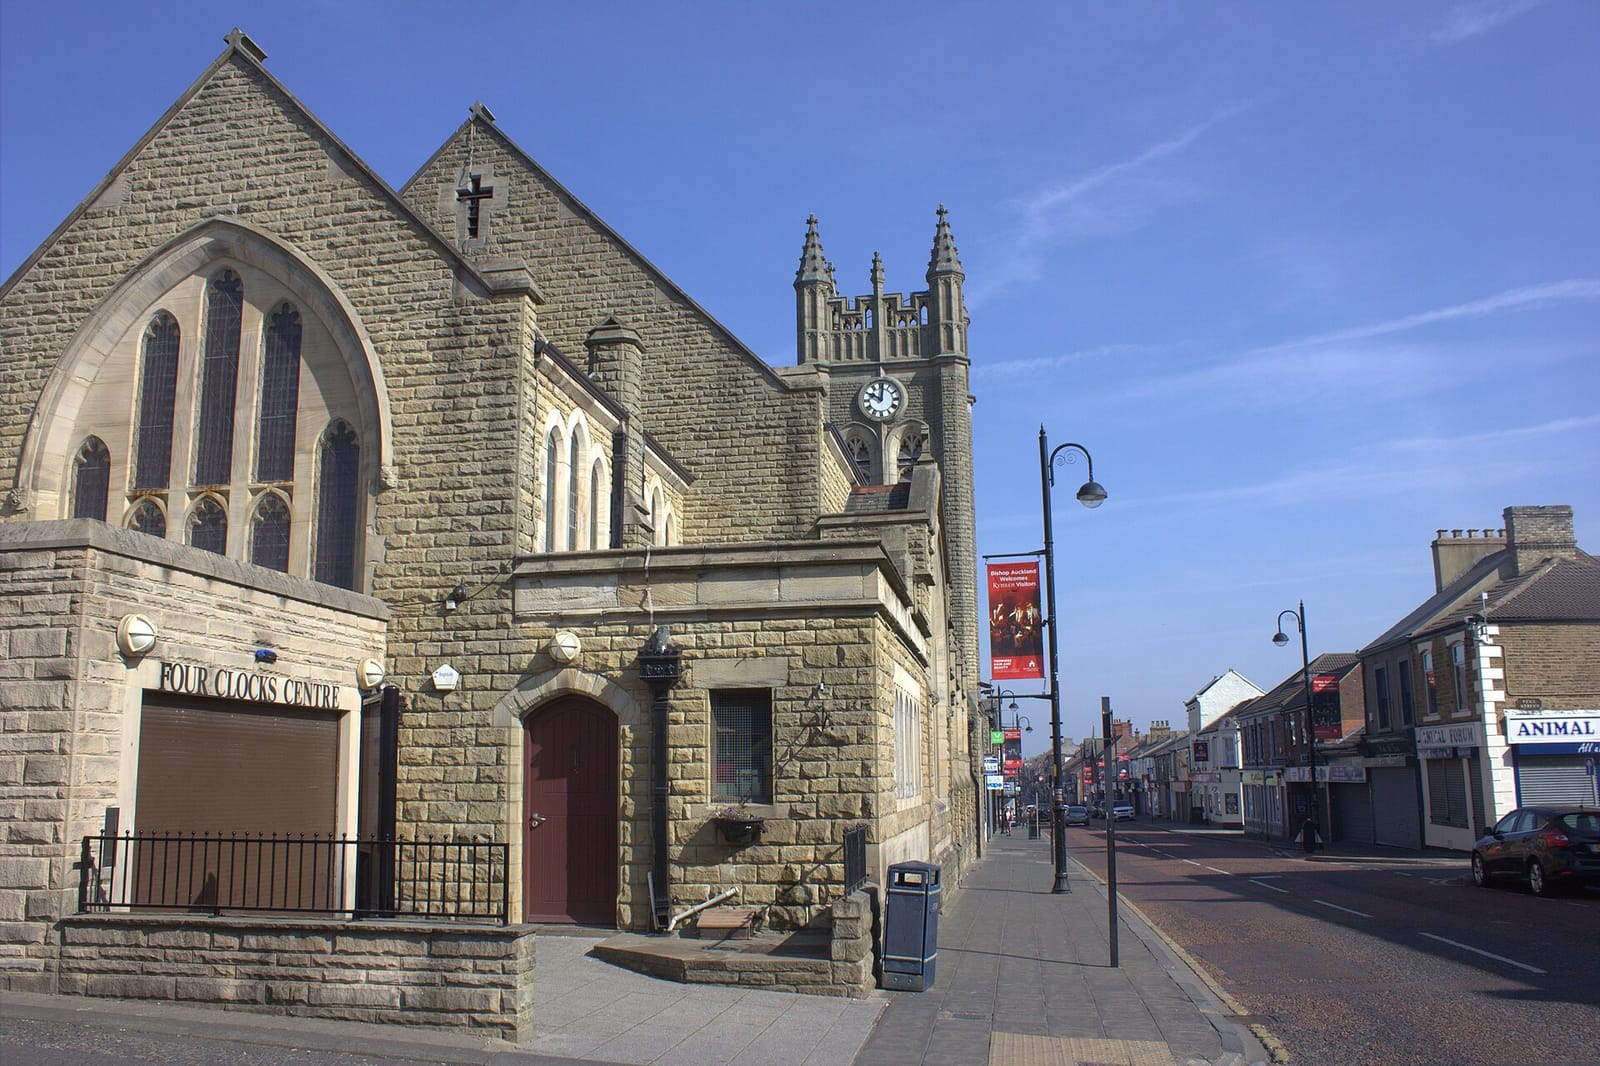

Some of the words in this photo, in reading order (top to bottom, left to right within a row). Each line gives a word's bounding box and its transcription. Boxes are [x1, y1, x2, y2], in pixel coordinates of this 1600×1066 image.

[159, 661, 208, 695] FOUR
[214, 669, 277, 703] CLOCKS
[283, 679, 340, 709] CENTRE
[1517, 721, 1595, 736] ANIMAL
[1578, 742, 1594, 753] All
